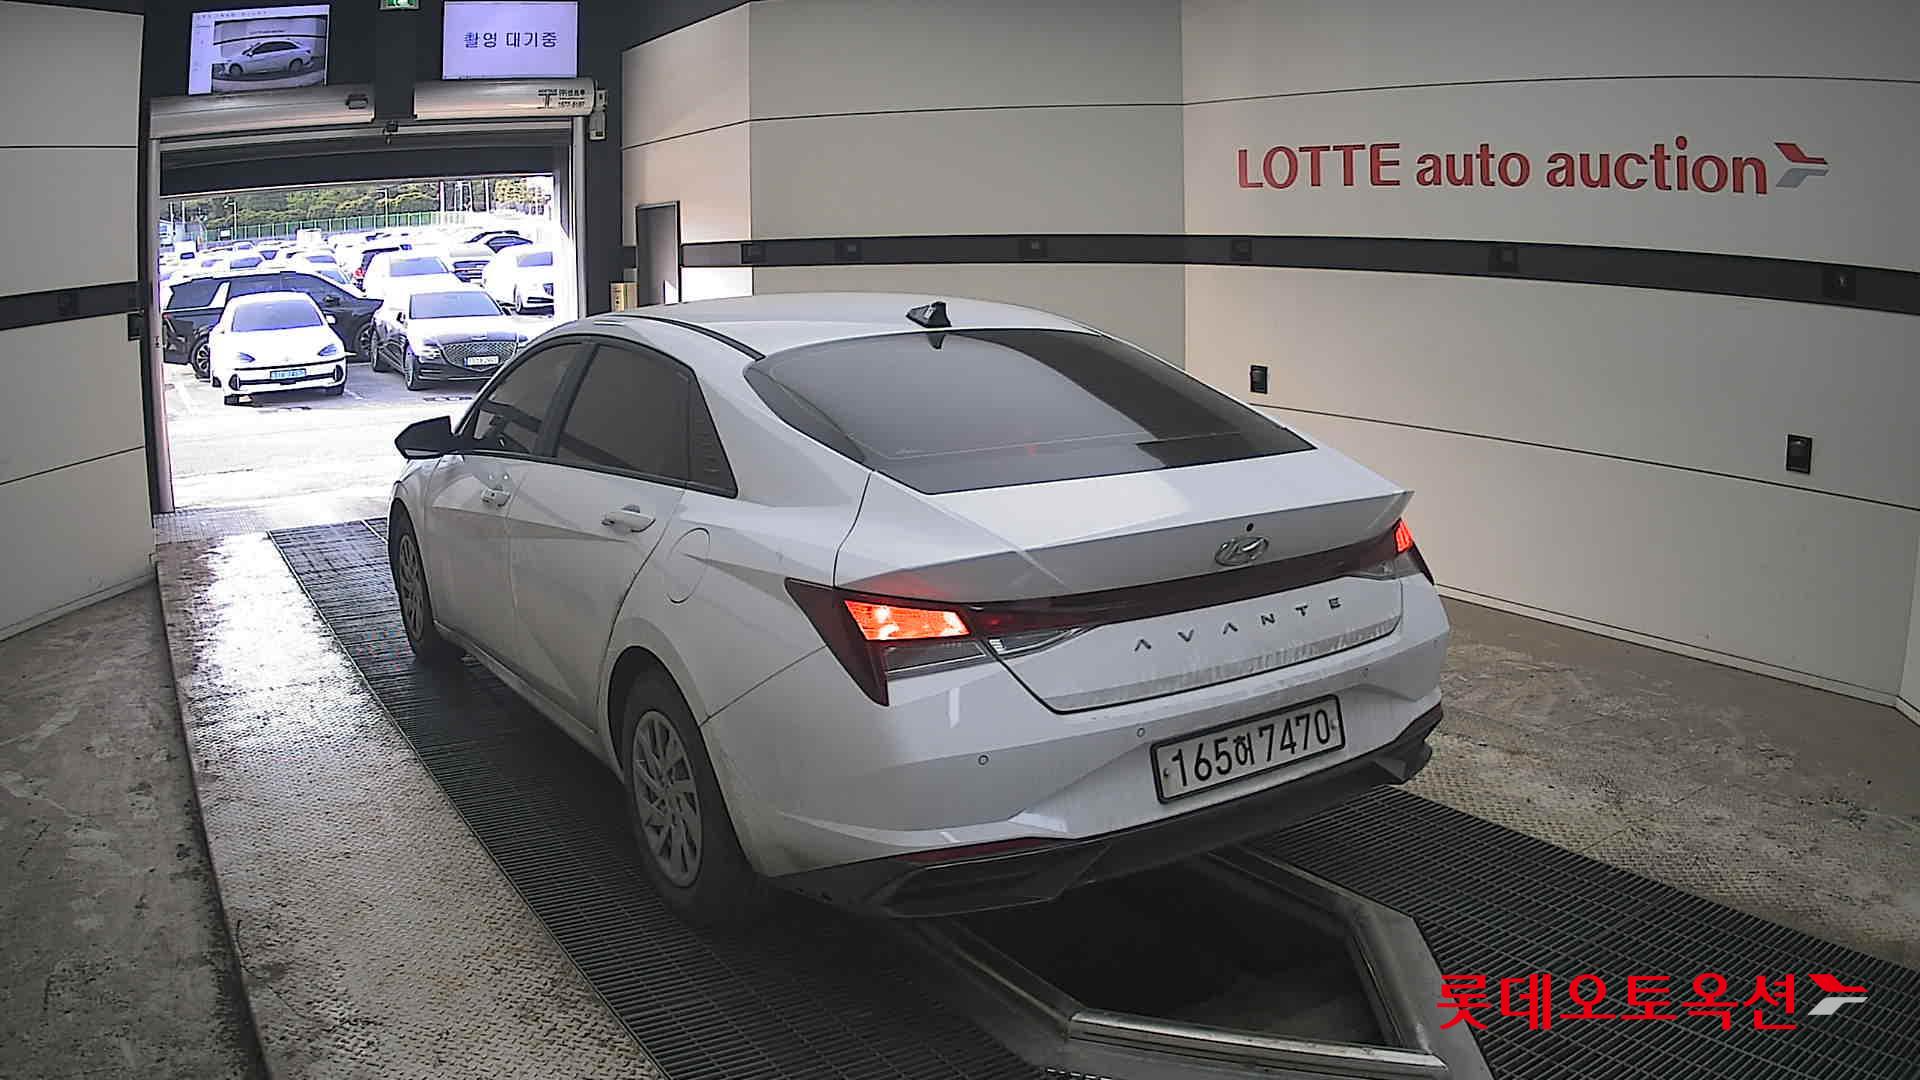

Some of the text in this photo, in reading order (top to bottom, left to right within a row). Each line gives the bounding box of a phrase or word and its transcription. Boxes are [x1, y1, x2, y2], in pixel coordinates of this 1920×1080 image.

[464, 31, 558, 49] 촬영 대기중
[1238, 136, 1767, 195] LOTTE auto auction
[1134, 596, 1342, 652] AVANTE
